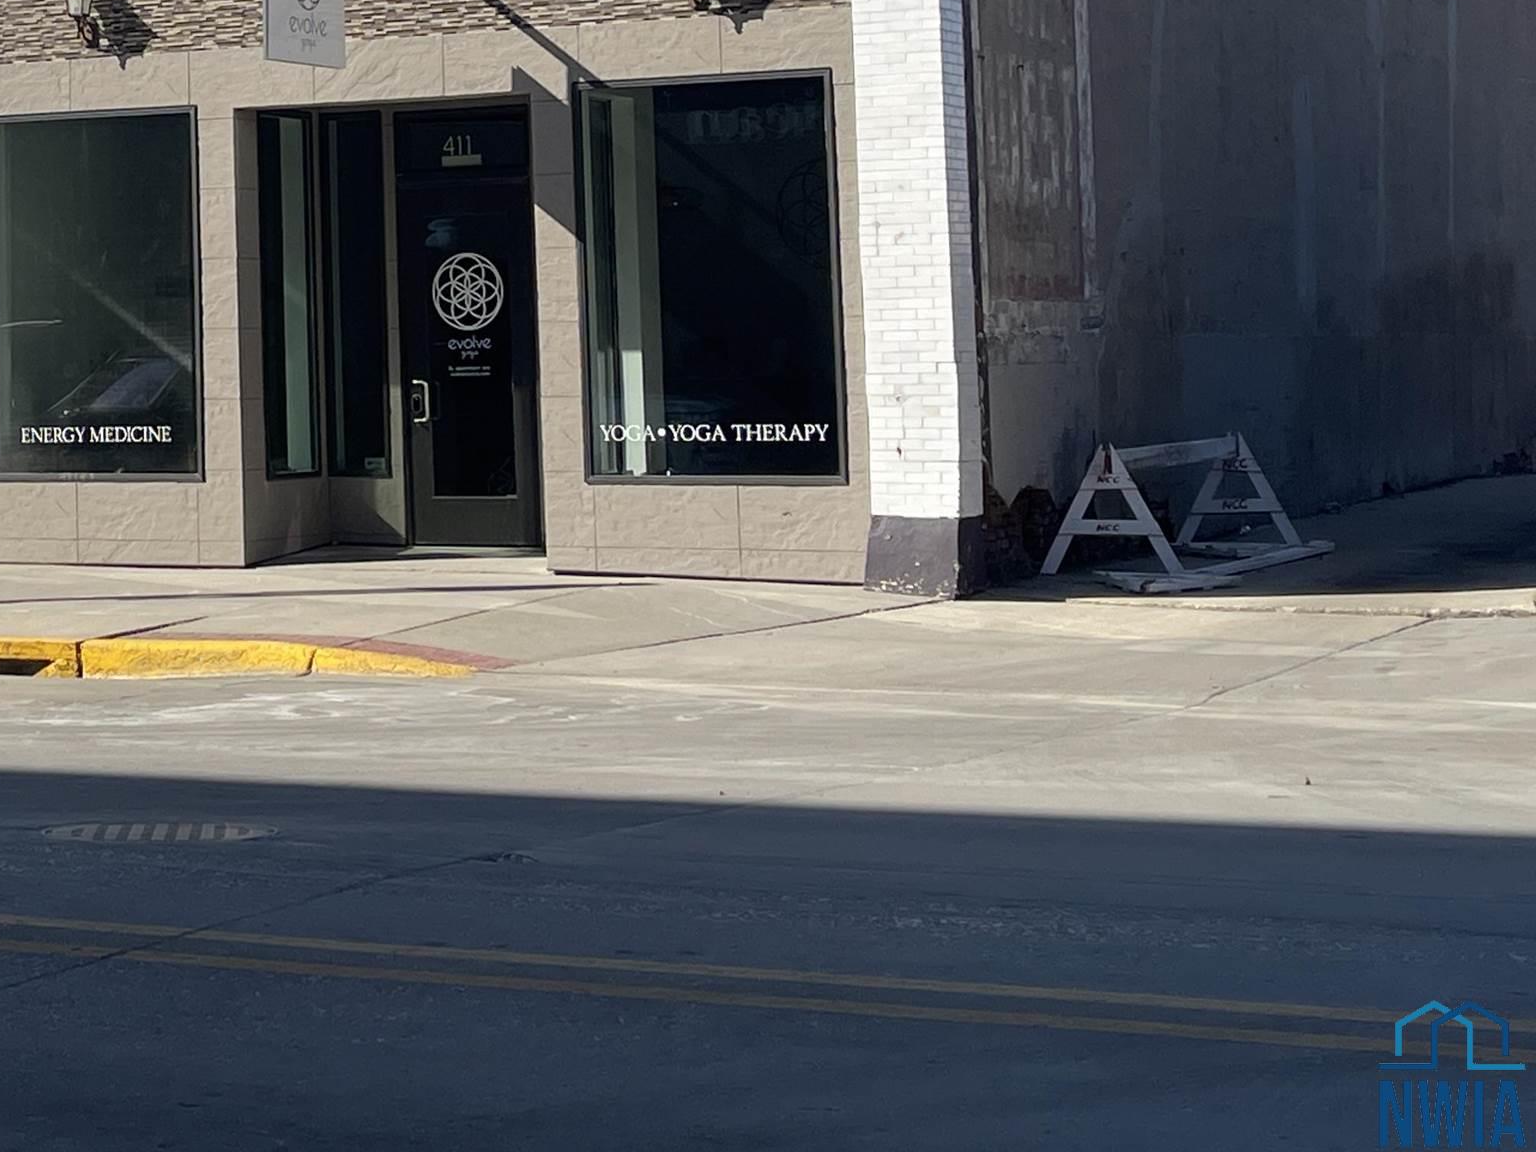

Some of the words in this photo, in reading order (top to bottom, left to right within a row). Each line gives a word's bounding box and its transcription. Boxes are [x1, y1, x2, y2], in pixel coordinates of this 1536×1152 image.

[442, 135, 473, 156] 411
[448, 335, 493, 350] evolve
[21, 426, 86, 444] ENERGY
[89, 426, 172, 443] MEDICINE
[599, 424, 657, 442] YOGA
[668, 424, 727, 442] YOGA
[731, 423, 830, 442] THERAPY
[1222, 498, 1248, 510] NCC
